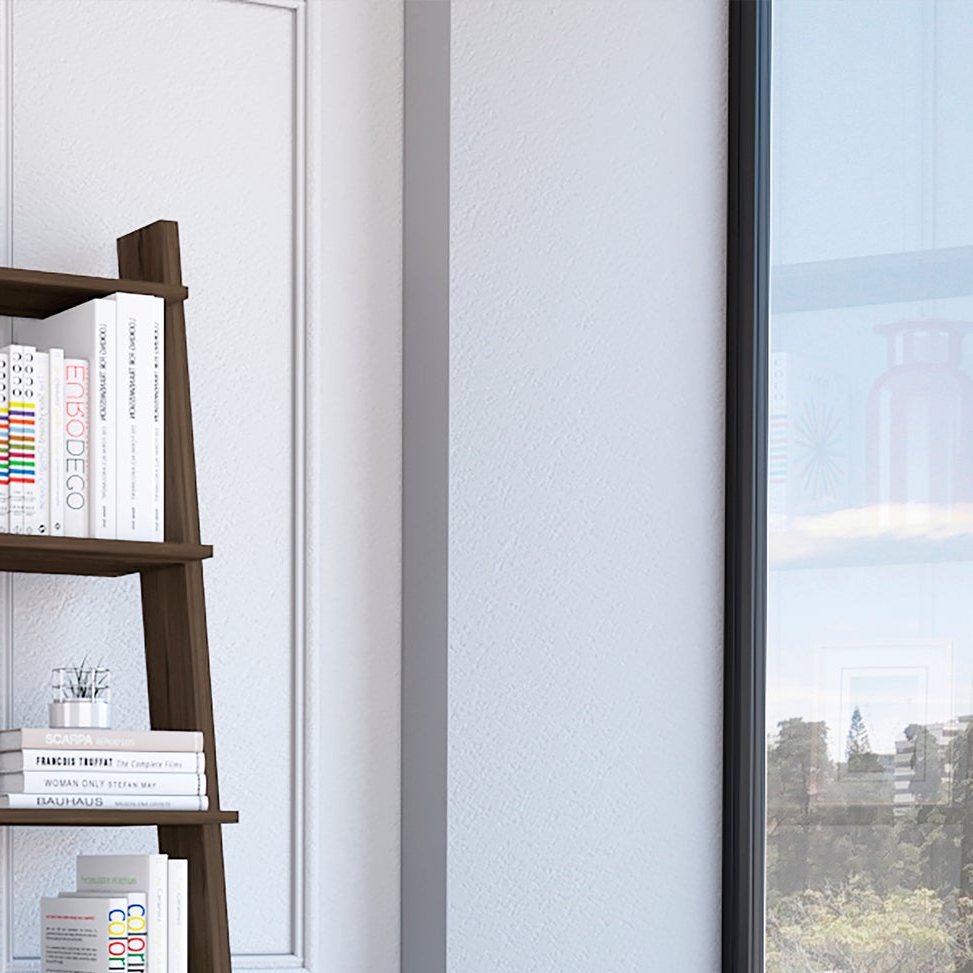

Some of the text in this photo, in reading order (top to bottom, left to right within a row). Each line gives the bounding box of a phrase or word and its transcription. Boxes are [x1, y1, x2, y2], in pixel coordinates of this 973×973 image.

[45, 733, 93, 745] SCARPA
[116, 759, 129, 767] The
[131, 760, 162, 769] Complete
[43, 778, 156, 789] WOMAN ONLY STEFAN MAY
[36, 796, 104, 807] BAUHAUS
